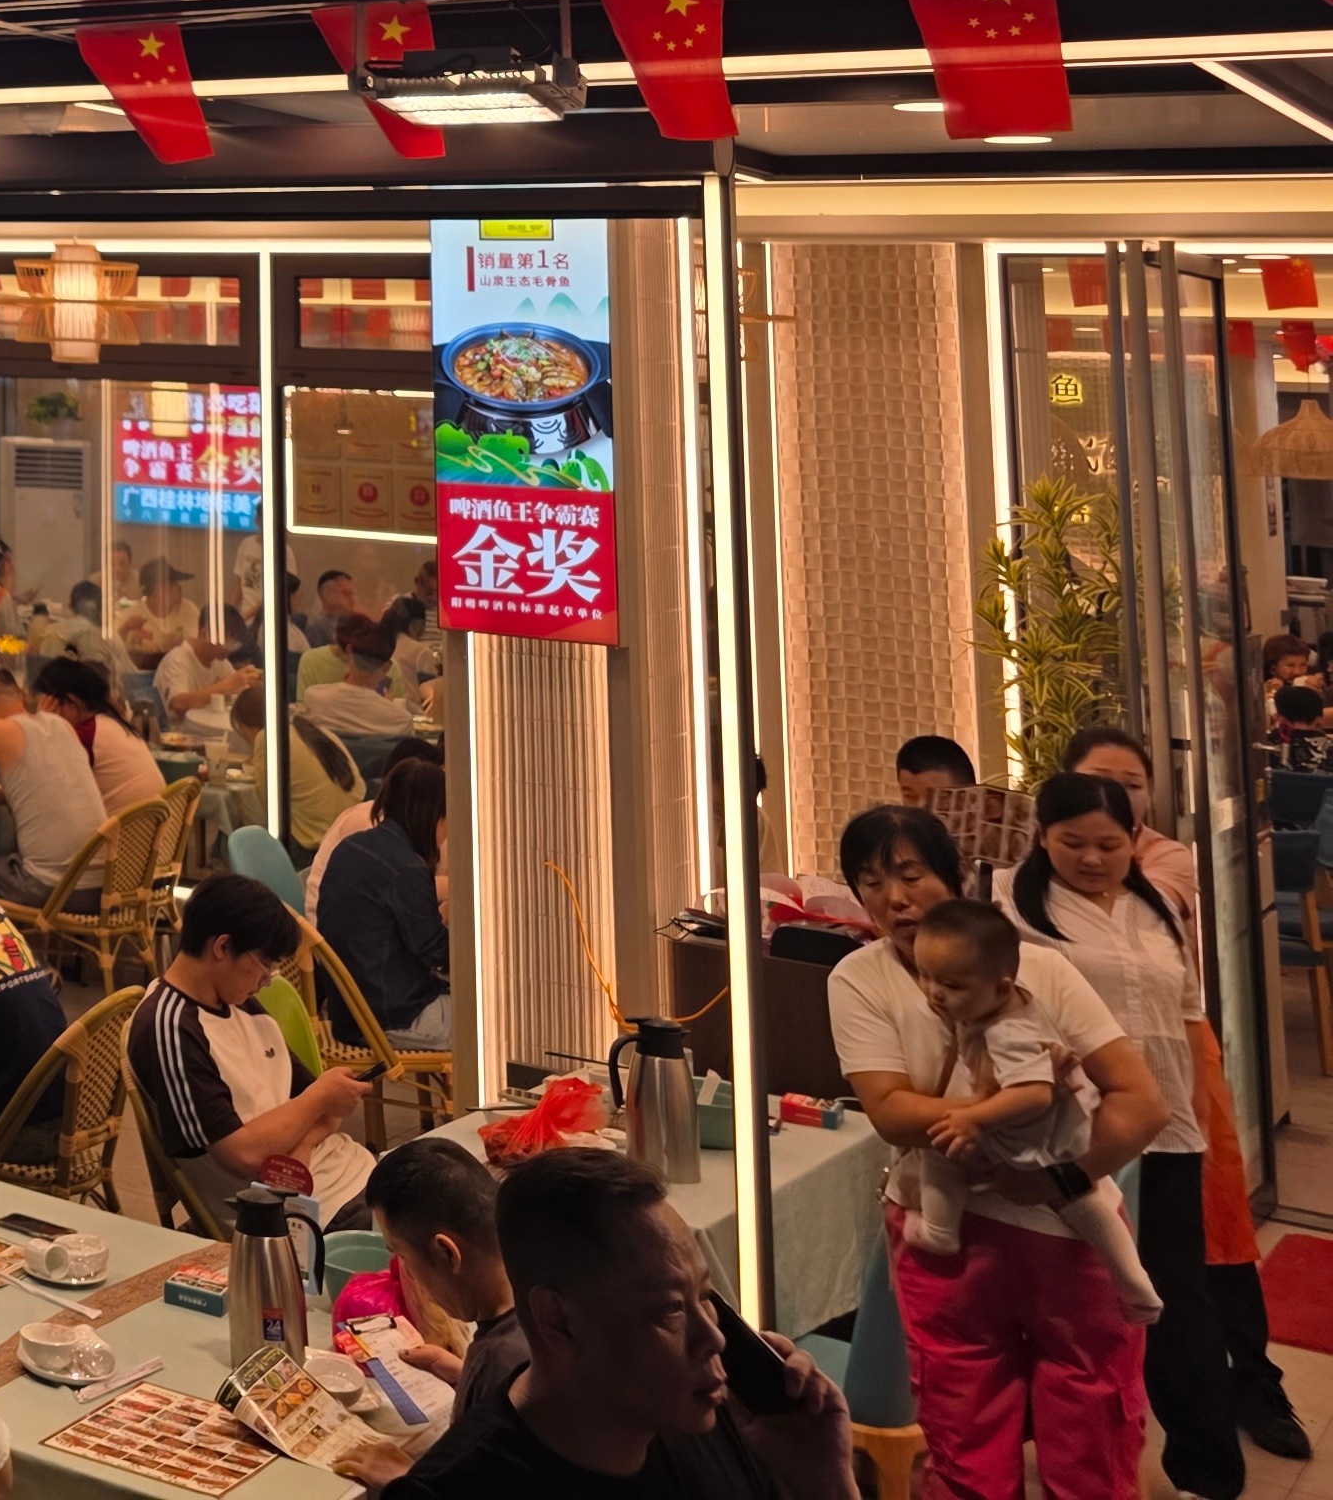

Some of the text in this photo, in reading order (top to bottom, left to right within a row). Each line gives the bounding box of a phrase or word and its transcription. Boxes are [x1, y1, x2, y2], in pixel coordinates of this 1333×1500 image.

[477, 249, 570, 270] 销量第1名
[479, 275, 571, 288] 山泉生态毛骨鱼
[194, 445, 262, 487] 金奖
[449, 497, 600, 529] 啤酒鱼王争霸赛
[451, 523, 602, 604] 金奖
[450, 596, 603, 621] 阳朔啤酒鱼标准起草单位
